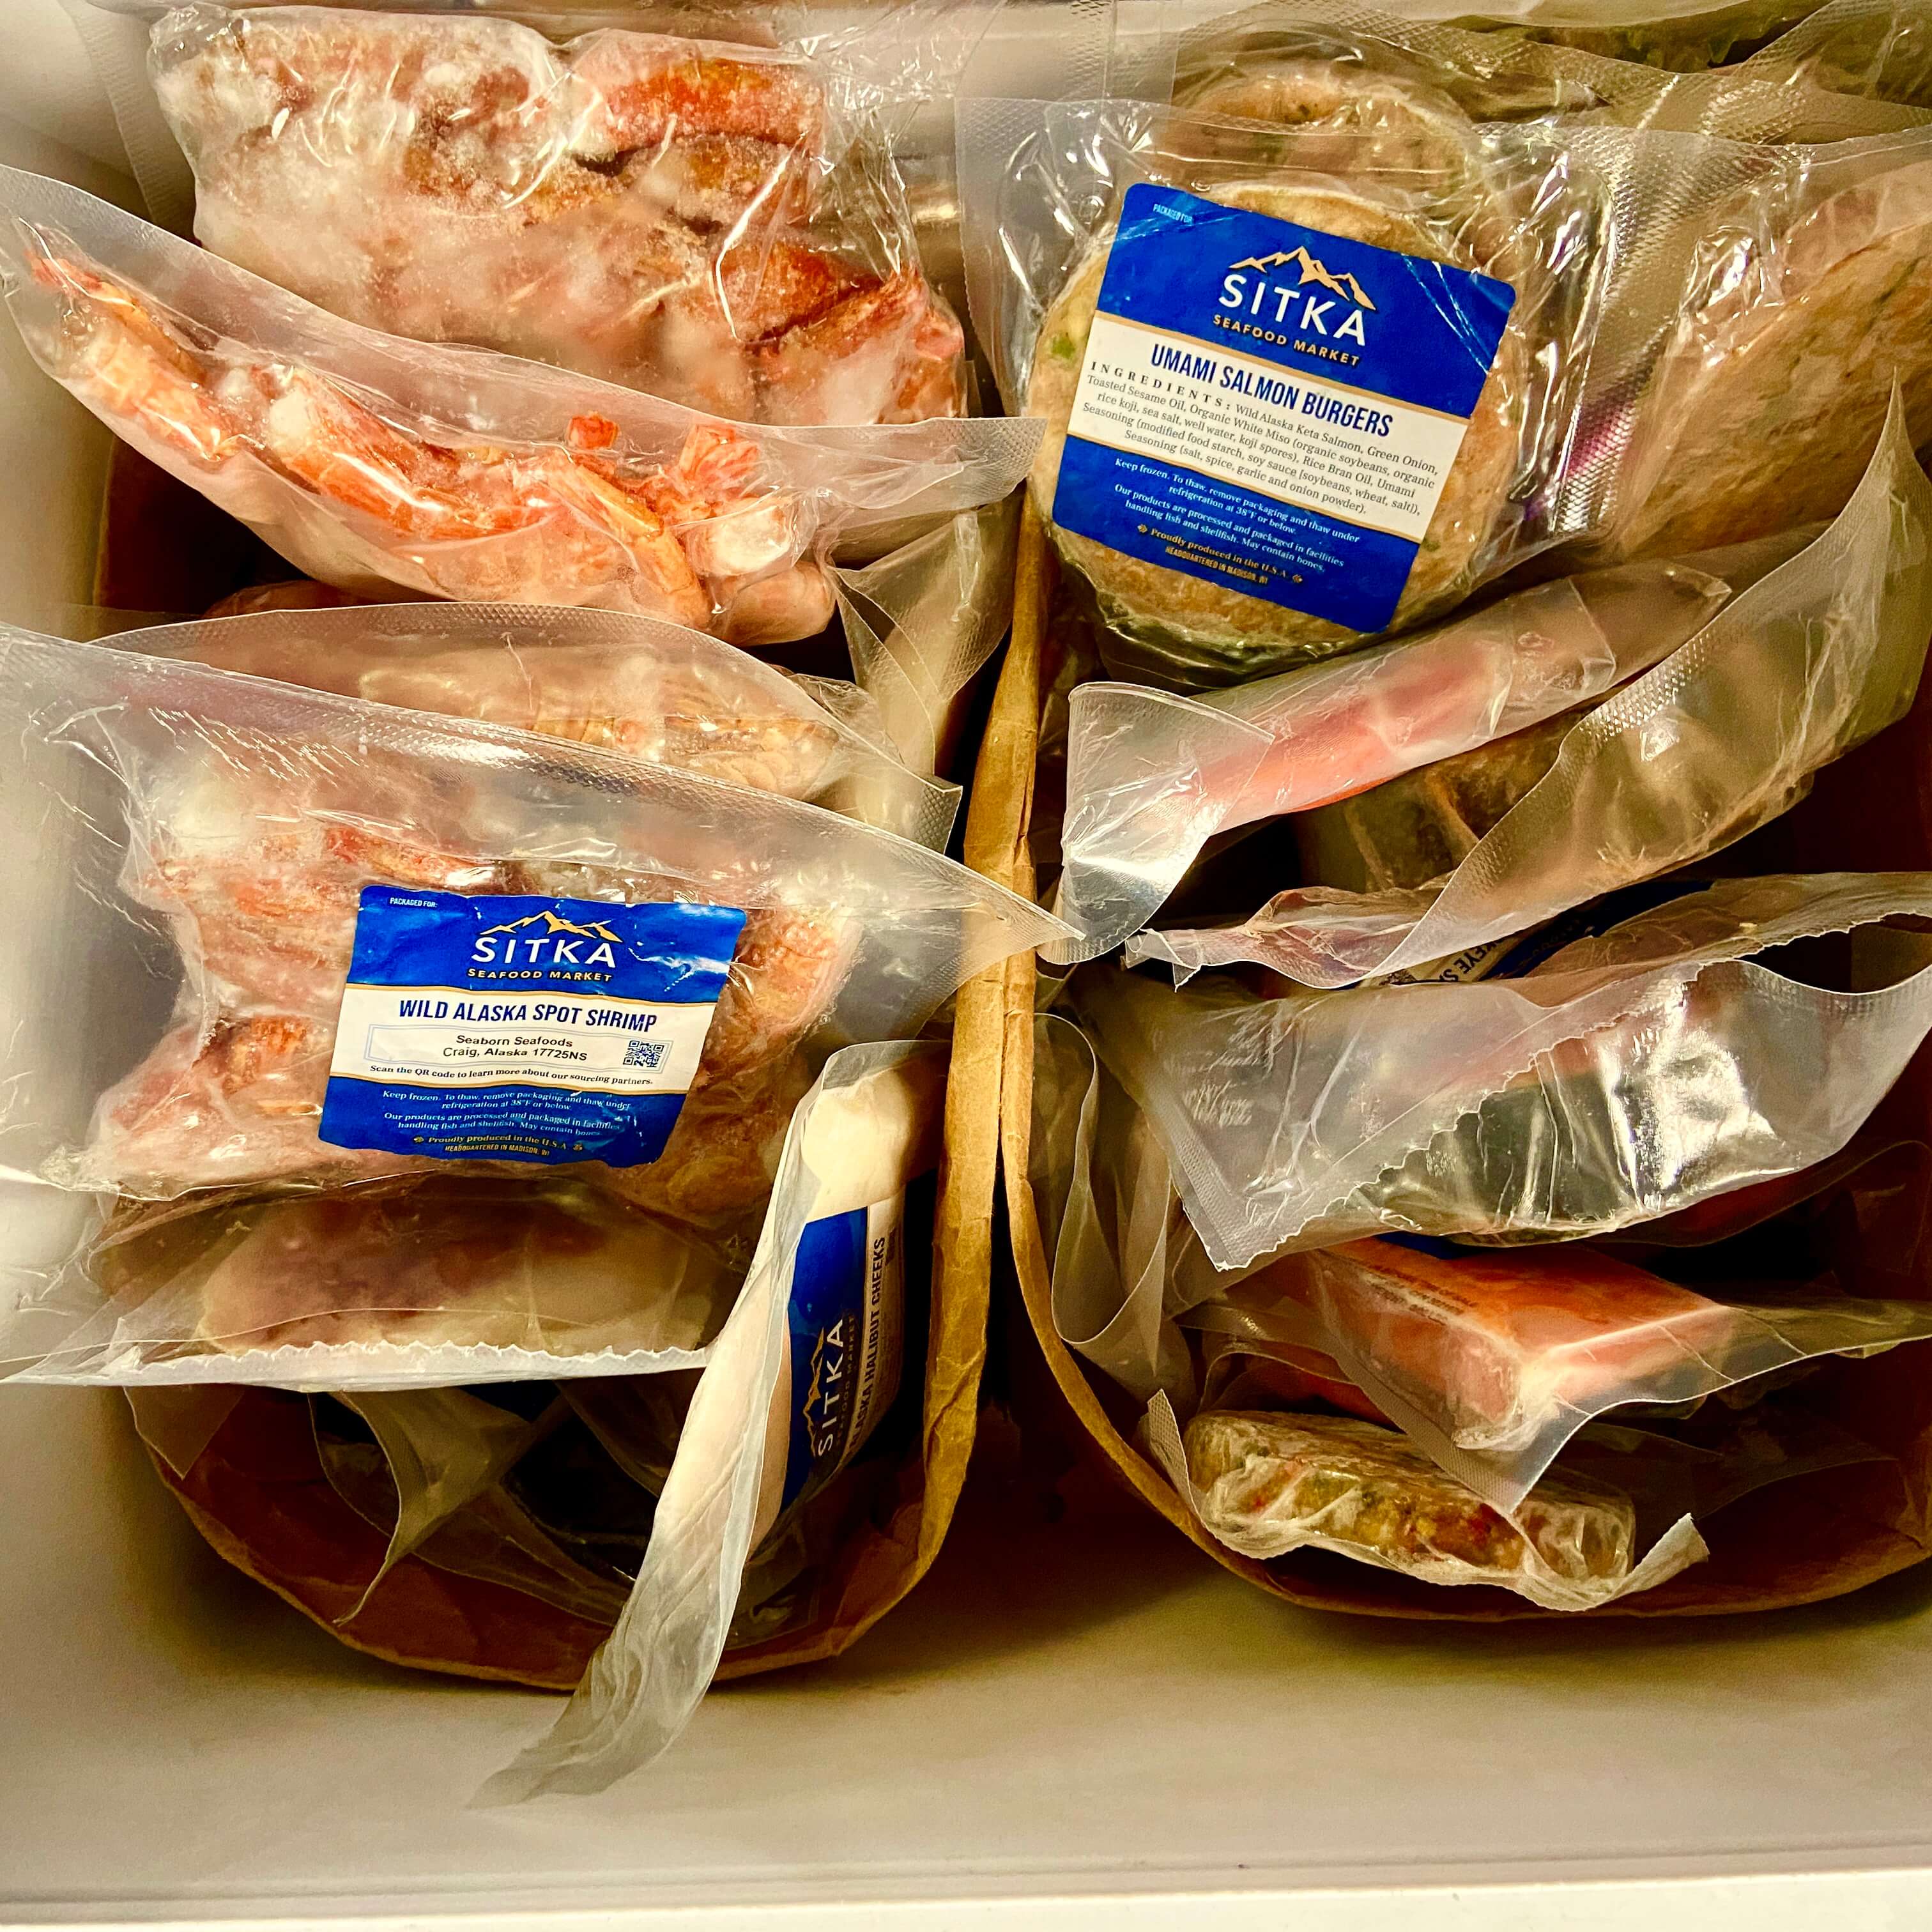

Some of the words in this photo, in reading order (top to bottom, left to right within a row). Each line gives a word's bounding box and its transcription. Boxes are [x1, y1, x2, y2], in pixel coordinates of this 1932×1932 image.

[1212, 314, 1287, 345] SEAFOOD
[1292, 339, 1360, 366] MARKET
[1218, 273, 1365, 346] SITKA
[1151, 343, 1217, 384] UMAMI
[1219, 365, 1300, 410] SALMON
[1300, 391, 1393, 437] BURGERS
[1082, 401, 1135, 427] Seasoning
[1136, 418, 1186, 440] (modified
[1186, 431, 1211, 448] food
[1246, 454, 1266, 467] soy
[1266, 460, 1297, 477] sauce
[1087, 374, 1126, 393] Toasted
[1126, 385, 1167, 405] Sesame
[1189, 403, 1231, 424] Organic
[1233, 417, 1263, 435] White
[1264, 427, 1291, 445] Miso
[1292, 437, 1337, 459] (organic
[1392, 470, 1435, 489] organic
[1096, 392, 1117, 404] rice
[1141, 406, 1159, 418] sea
[1184, 418, 1206, 431] well
[1238, 433, 1258, 449] koji
[1301, 455, 1326, 471] Rice
[1326, 463, 1353, 480] Bran
[1376, 477, 1416, 498] Umami
[1236, 403, 1259, 420] Wild
[1258, 413, 1294, 431] Alaska
[1295, 423, 1319, 440] Keta
[1367, 445, 1400, 463] Green
[1124, 429, 1178, 454] Seasoning
[1236, 465, 1267, 481] garlic
[1267, 475, 1289, 489] and
[1289, 483, 1319, 499] onion
[1114, 483, 1133, 496] Our
[1131, 491, 1170, 509] products
[1171, 504, 1187, 514] are
[1186, 509, 1233, 529] processed
[1232, 524, 1251, 535] and
[1250, 530, 1294, 549] packaged
[1294, 542, 1304, 553] in
[1305, 546, 1344, 567] facilities
[1124, 498, 1164, 520] handling
[1164, 511, 1181, 524] fish
[1181, 519, 1200, 530] and
[1241, 537, 1261, 551] May
[1261, 544, 1295, 561] contain
[390, 897, 422, 907] PACKAGED
[467, 967, 542, 979] SEAFOOD
[549, 970, 612, 982] MARKET
[470, 937, 617, 969] SITKA
[399, 999, 448, 1018] WILD
[452, 1002, 527, 1022] ALASKA
[532, 1003, 583, 1024] SPOT
[585, 1008, 657, 1032] SHRIMP
[455, 1034, 510, 1046] Seaborn
[513, 1035, 573, 1048] Seafoods
[369, 1064, 394, 1073] Scan
[414, 1068, 429, 1076] QR
[468, 1070, 493, 1078] learn
[521, 1068, 549, 1078] about
[569, 1074, 611, 1084] sourcing
[442, 1046, 480, 1058] Craig,
[483, 1047, 528, 1057] Alaska
[533, 1047, 588, 1061] 17725NS
[466, 1133, 511, 1143] produced
[524, 1135, 540, 1144] the
[871, 1237, 885, 1306] CHEEKS
[864, 1310, 880, 1383] HALIBUT
[818, 1319, 843, 1457] SITKA
